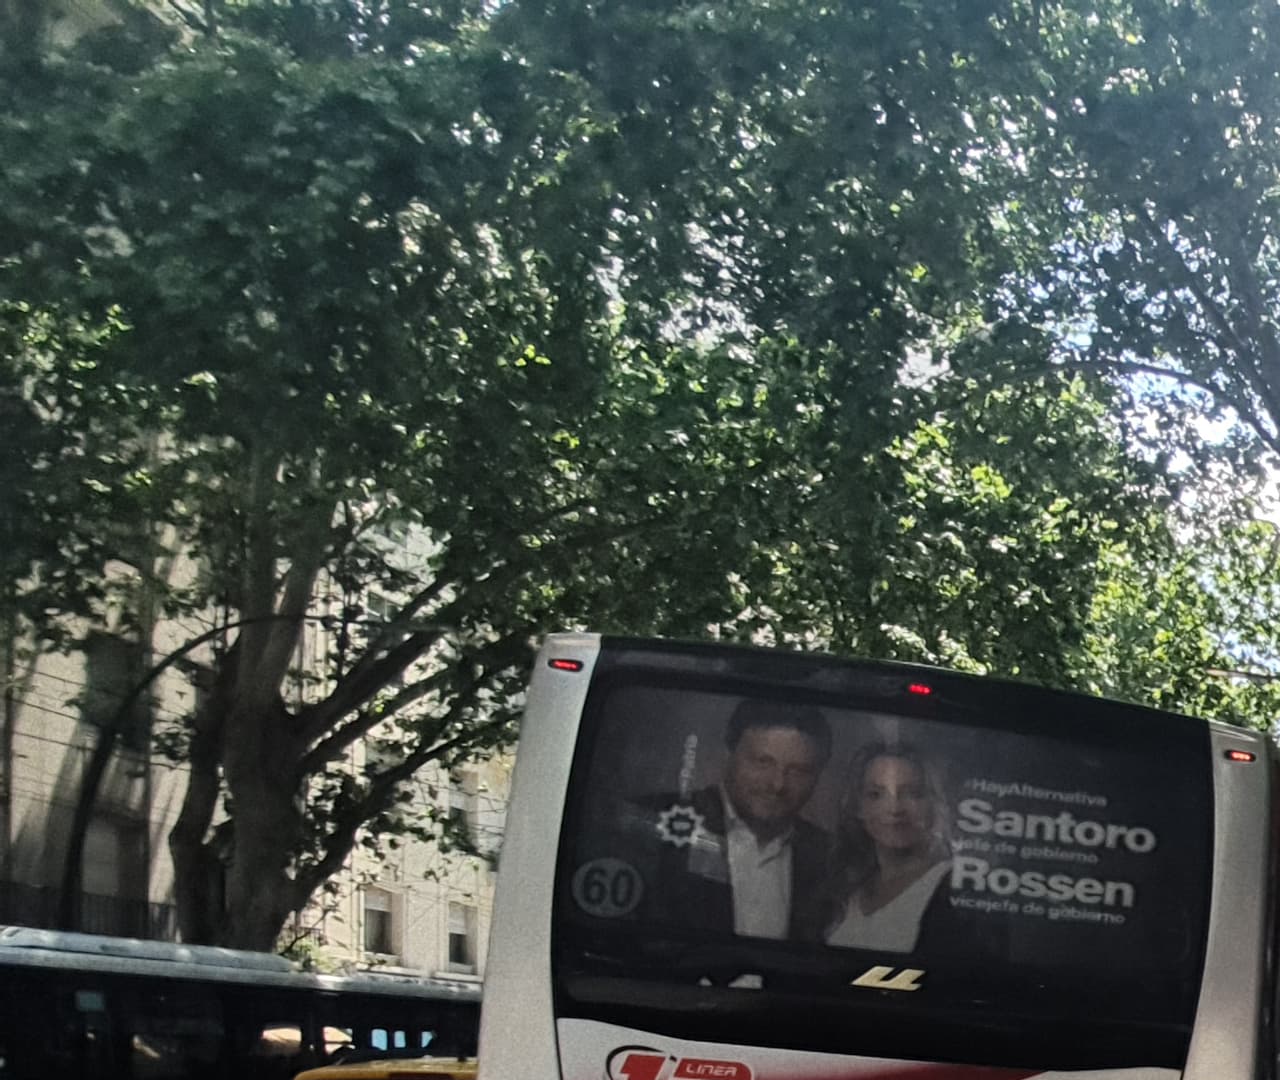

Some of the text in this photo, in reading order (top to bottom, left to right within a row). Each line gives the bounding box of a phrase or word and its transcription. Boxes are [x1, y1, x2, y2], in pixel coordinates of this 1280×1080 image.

[957, 798, 1156, 852] Santoro
[994, 841, 1017, 854] de
[1020, 847, 1098, 864] gobierno
[582, 867, 636, 908] 60
[951, 855, 1135, 908] Rossen
[1022, 902, 1044, 915] de
[1048, 907, 1126, 925] gobierno
